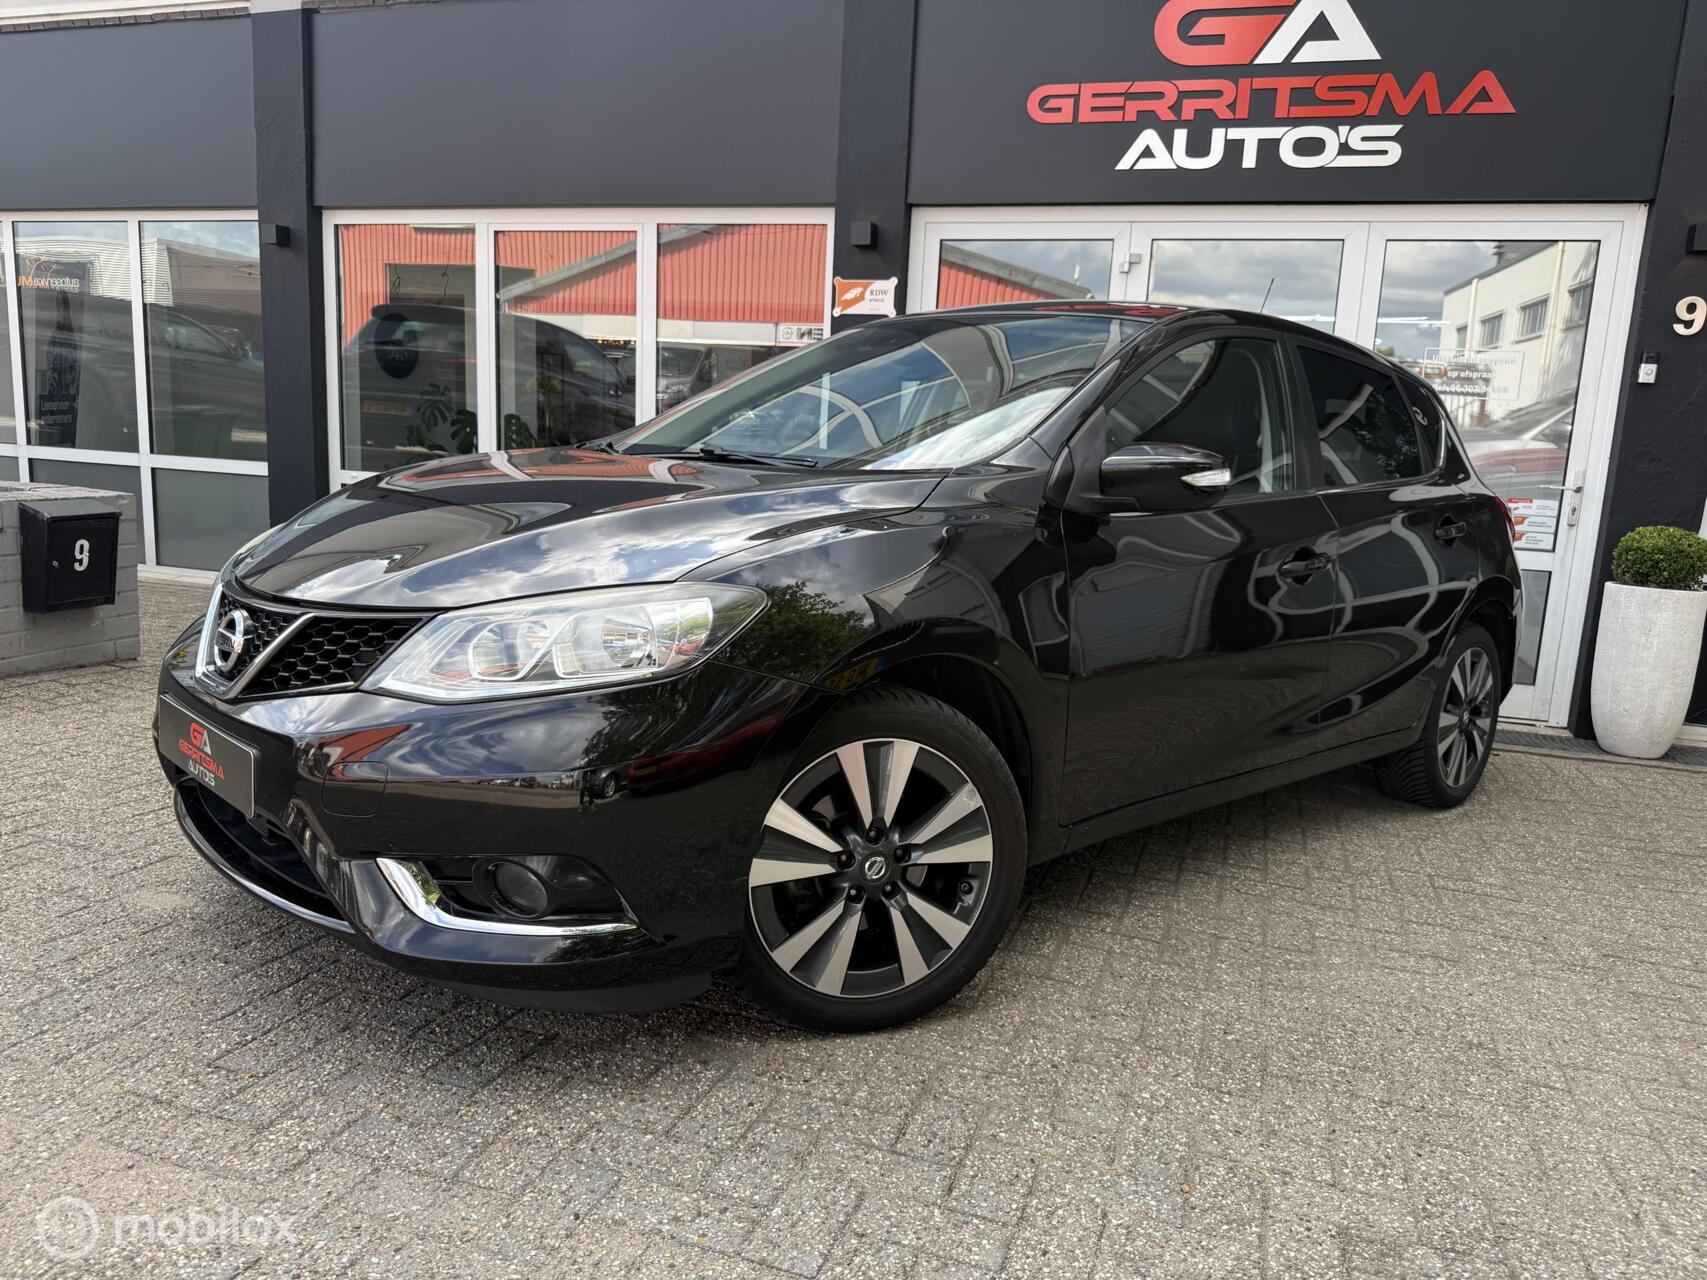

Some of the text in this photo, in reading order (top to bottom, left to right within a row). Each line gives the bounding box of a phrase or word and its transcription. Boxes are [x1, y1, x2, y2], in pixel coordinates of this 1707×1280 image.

[1154, 0, 1382, 66] GA
[1027, 70, 1517, 123] GERRITSMA
[1114, 124, 1403, 170] AUTO'S
[1672, 295, 1707, 336] 9
[1447, 371, 1458, 379] op
[73, 539, 90, 572] 9
[179, 738, 225, 780] GERRITSMA
[190, 722, 212, 755] GA
